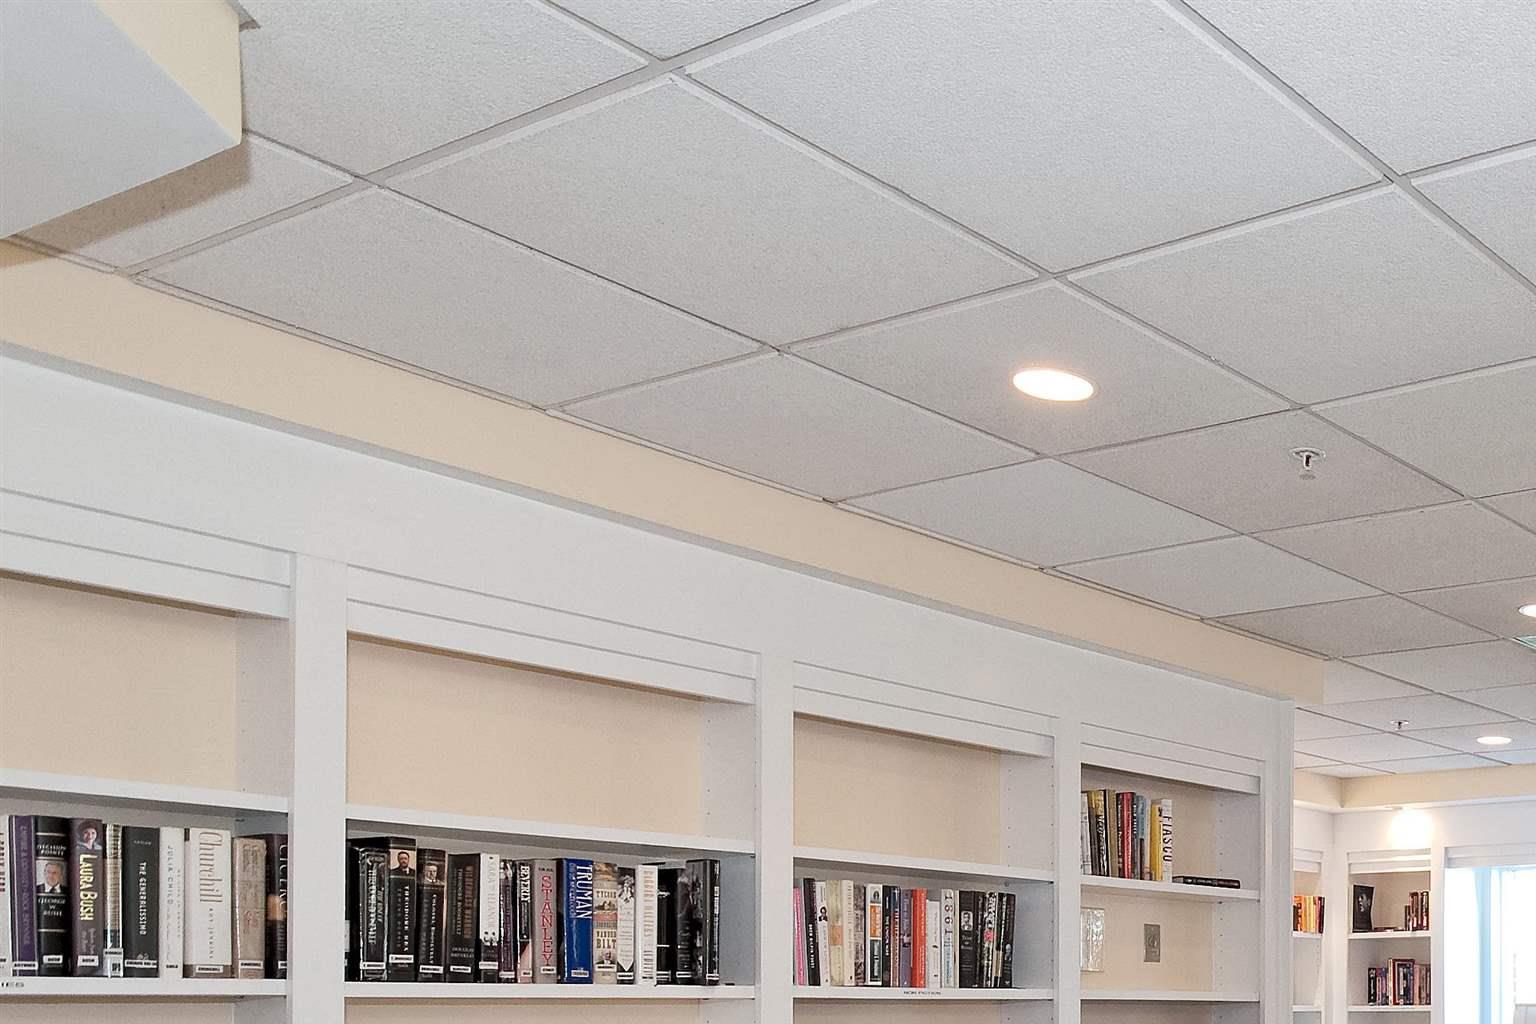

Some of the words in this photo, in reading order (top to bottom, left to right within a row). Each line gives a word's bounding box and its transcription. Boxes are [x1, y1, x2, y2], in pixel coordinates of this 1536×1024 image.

[79, 853, 98, 889] LAURA
[139, 862, 147, 877] THE
[199, 831, 223, 903] Churchill
[520, 865, 531, 903] BEVERLY
[79, 891, 98, 921] BUSH
[139, 878, 147, 936] GENERALISSIMO
[576, 863, 593, 919] TRUMAN
[540, 875, 554, 966] STANLEY
